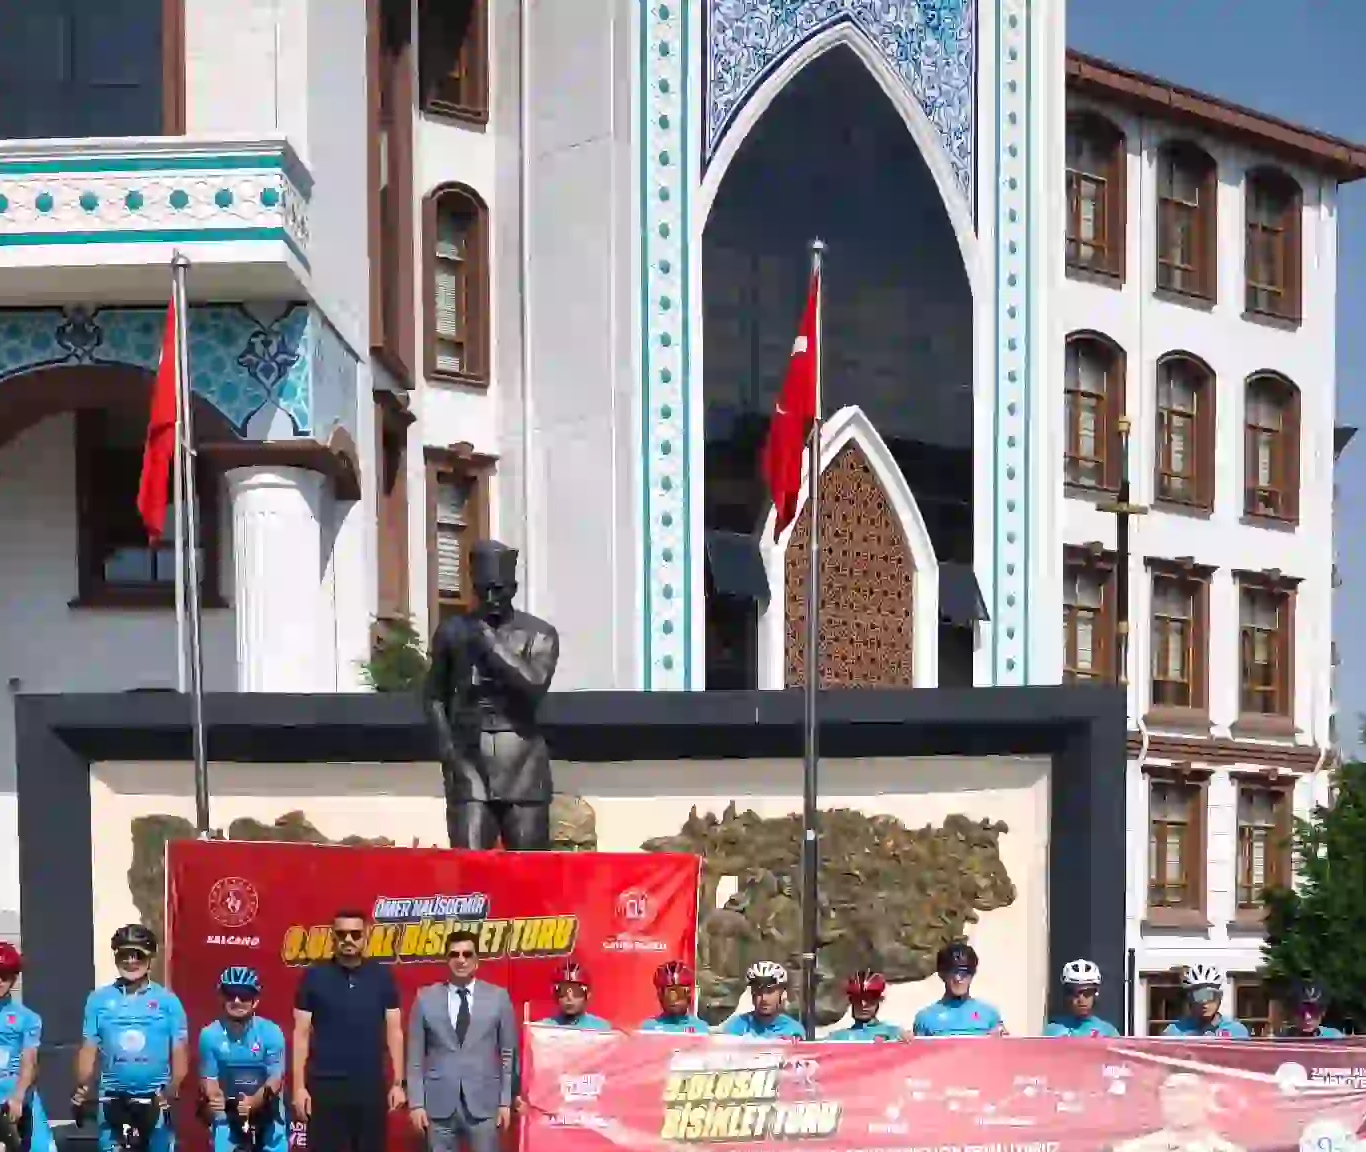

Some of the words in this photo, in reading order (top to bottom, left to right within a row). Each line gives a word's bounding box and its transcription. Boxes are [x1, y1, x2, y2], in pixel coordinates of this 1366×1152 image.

[508, 914, 577, 953] TURU
[660, 1101, 771, 1139] BİSİKLET
[773, 1101, 839, 1135] TURU
